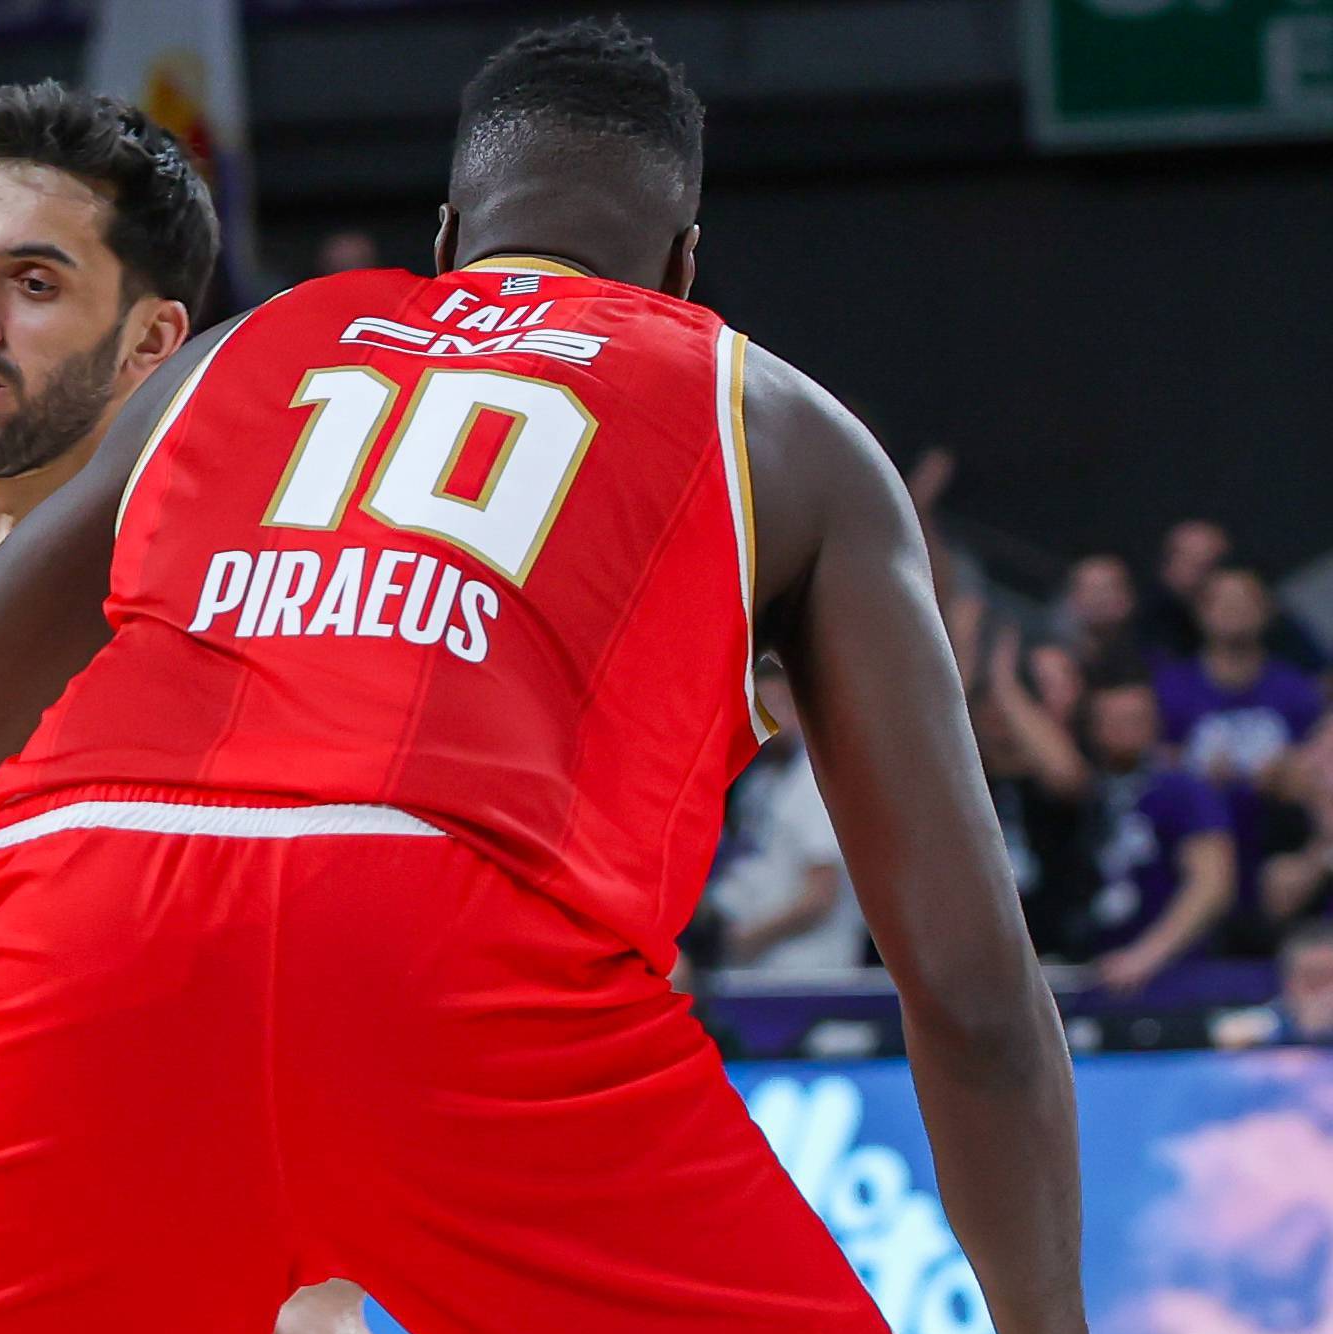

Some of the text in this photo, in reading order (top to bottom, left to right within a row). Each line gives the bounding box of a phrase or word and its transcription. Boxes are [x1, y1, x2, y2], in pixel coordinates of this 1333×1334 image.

[431, 288, 556, 332] FALL
[260, 365, 599, 589] 10
[187, 546, 501, 664] PIRAEUS
